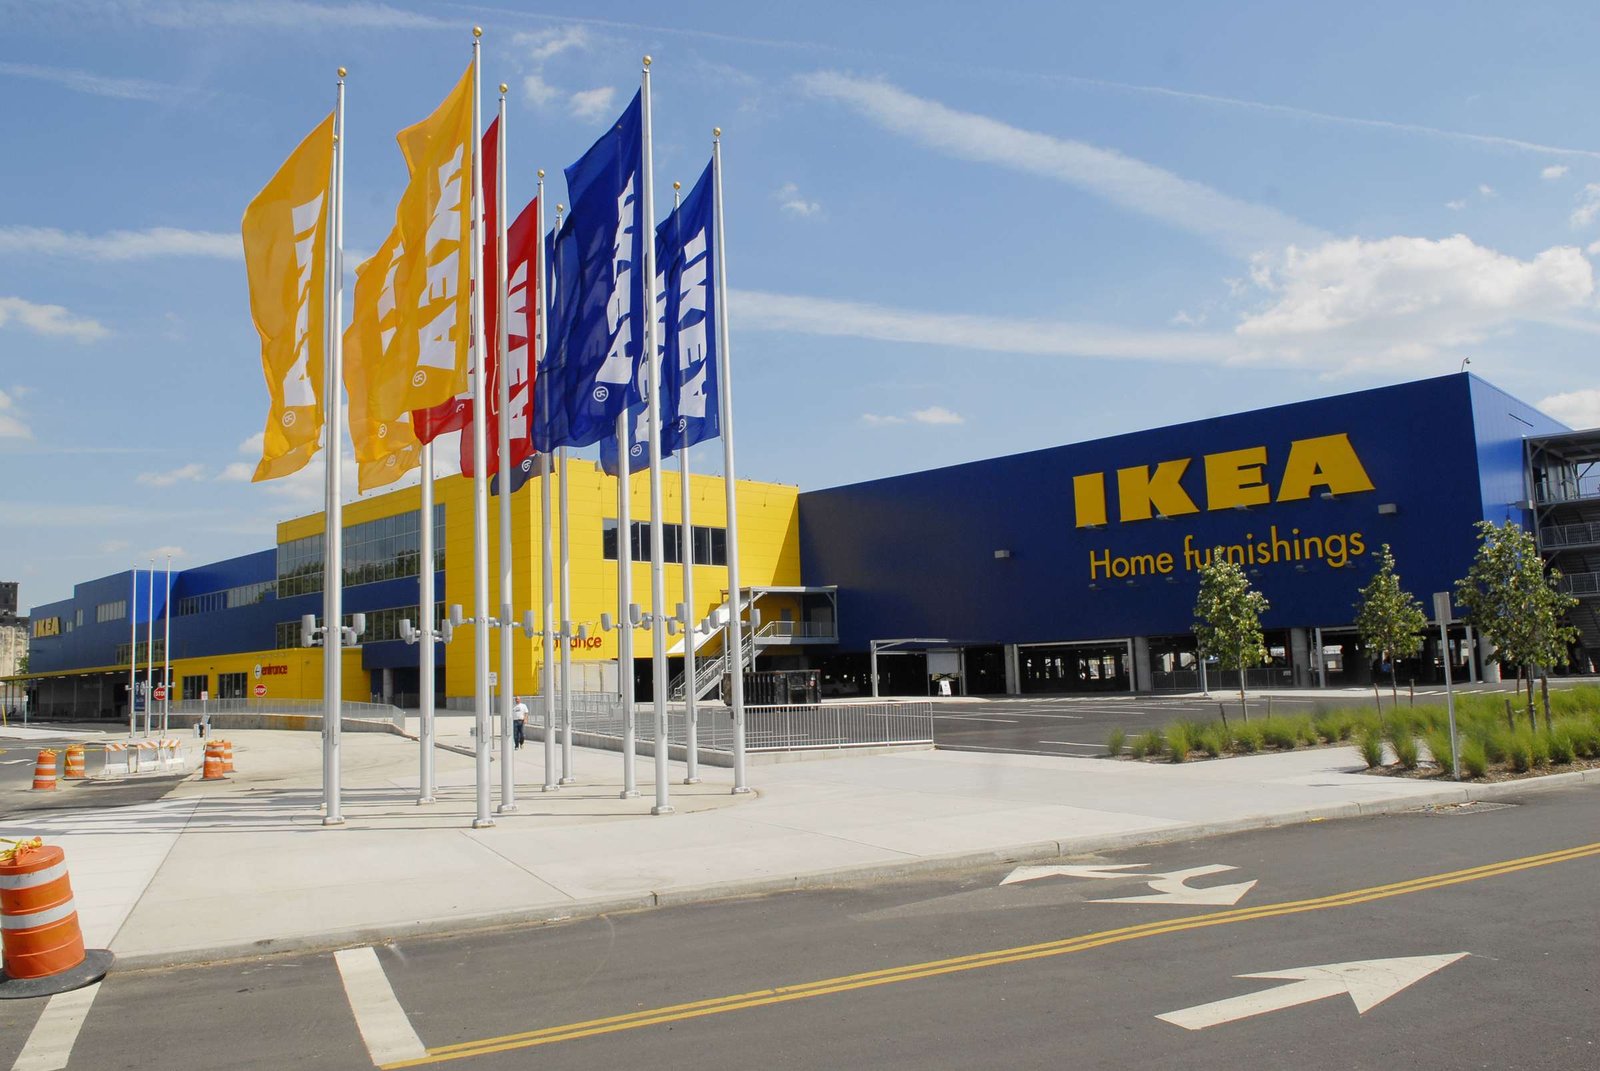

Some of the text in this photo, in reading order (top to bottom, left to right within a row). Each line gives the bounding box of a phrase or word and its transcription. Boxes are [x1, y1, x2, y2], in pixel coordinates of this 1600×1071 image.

[1073, 433, 1376, 528] IKEA
[1089, 549, 1174, 580] Home
[33, 616, 60, 637] IKEA
[541, 633, 602, 648] nance
[261, 664, 288, 675] entrance
